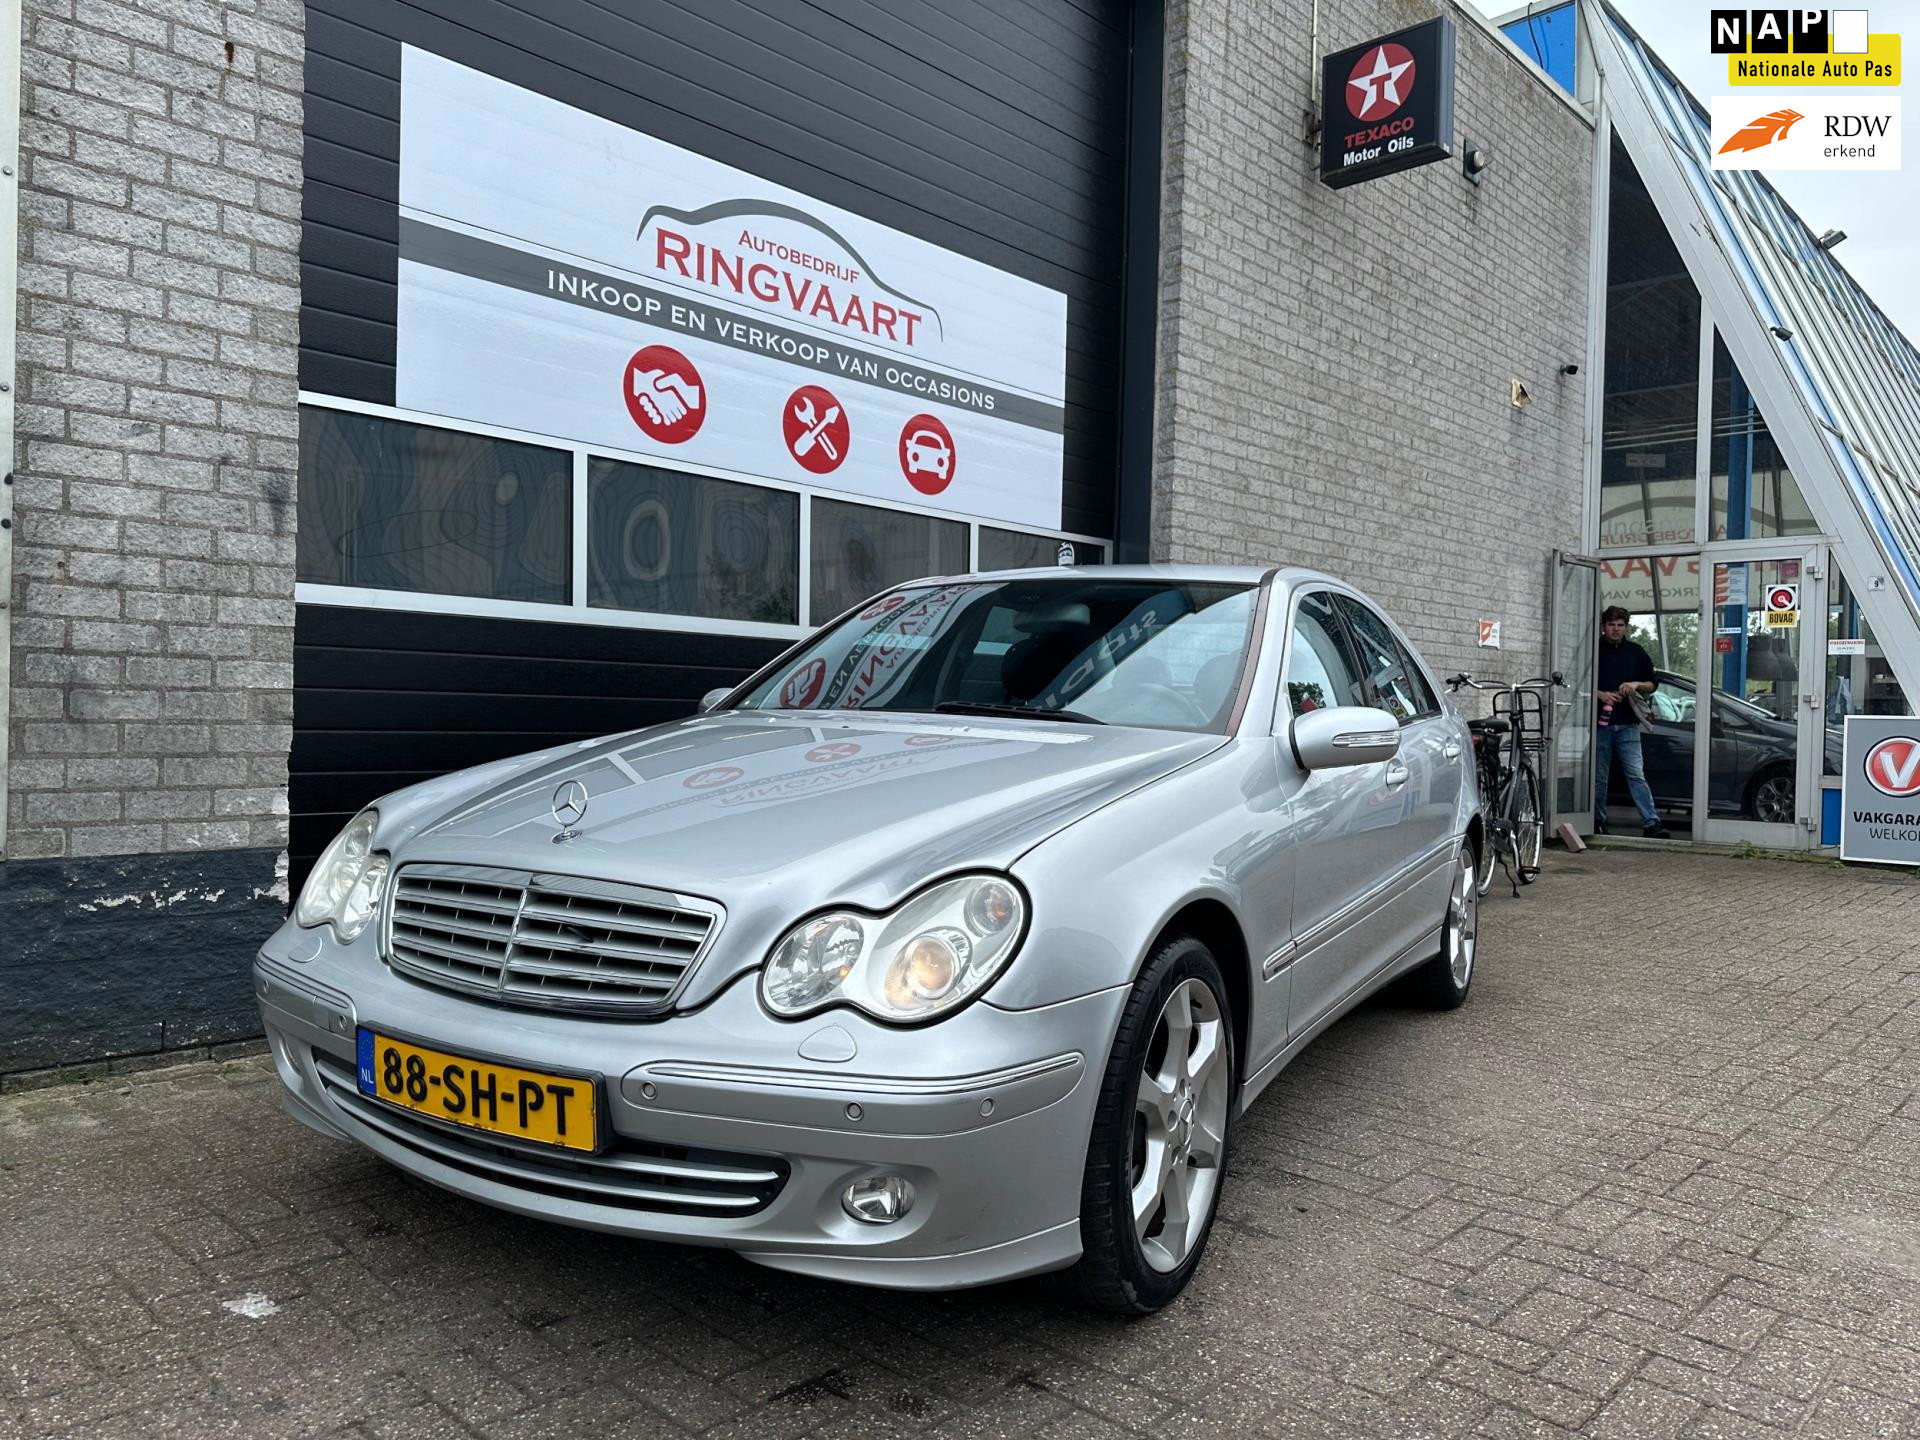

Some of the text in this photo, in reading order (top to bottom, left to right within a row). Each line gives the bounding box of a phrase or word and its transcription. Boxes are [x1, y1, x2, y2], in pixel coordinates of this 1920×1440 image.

[1344, 116, 1415, 148] TEXACO
[1343, 136, 1414, 167] Motor Oils
[738, 230, 860, 284] AUTOBEDRIJF
[655, 227, 922, 347] RINGVAART
[547, 269, 995, 411] INKOOP EN VERKOOP VAN OCCASIONS
[1874, 580, 1879, 588] 9
[1769, 613, 1793, 624] BOVAG
[1869, 827, 1920, 842] WELKO
[361, 1067, 375, 1085] NL
[383, 1047, 575, 1135] 88-SH-PT
